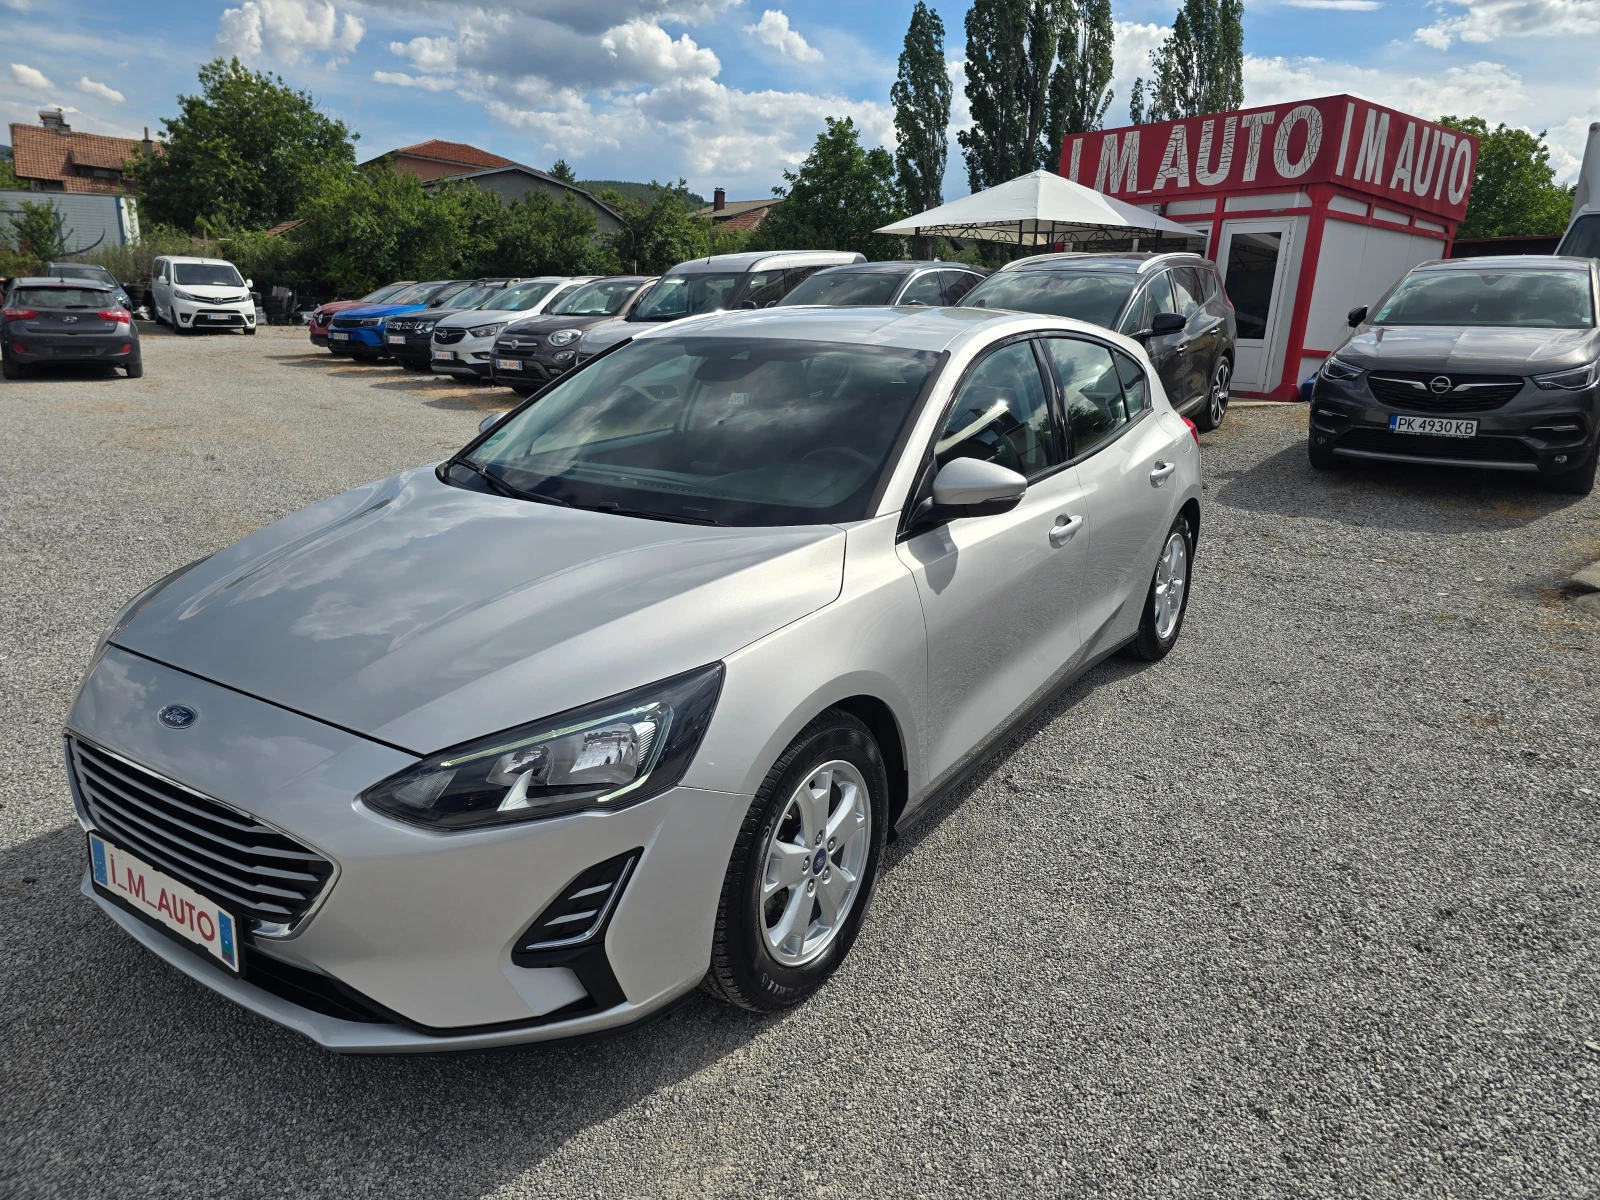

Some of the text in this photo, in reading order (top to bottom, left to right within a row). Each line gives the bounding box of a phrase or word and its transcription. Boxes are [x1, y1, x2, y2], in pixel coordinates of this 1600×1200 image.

[1335, 102, 1472, 205] I M AUTO
[1398, 417, 1416, 431] PK
[1418, 419, 1452, 433] 4930
[1454, 421, 1474, 434] KB
